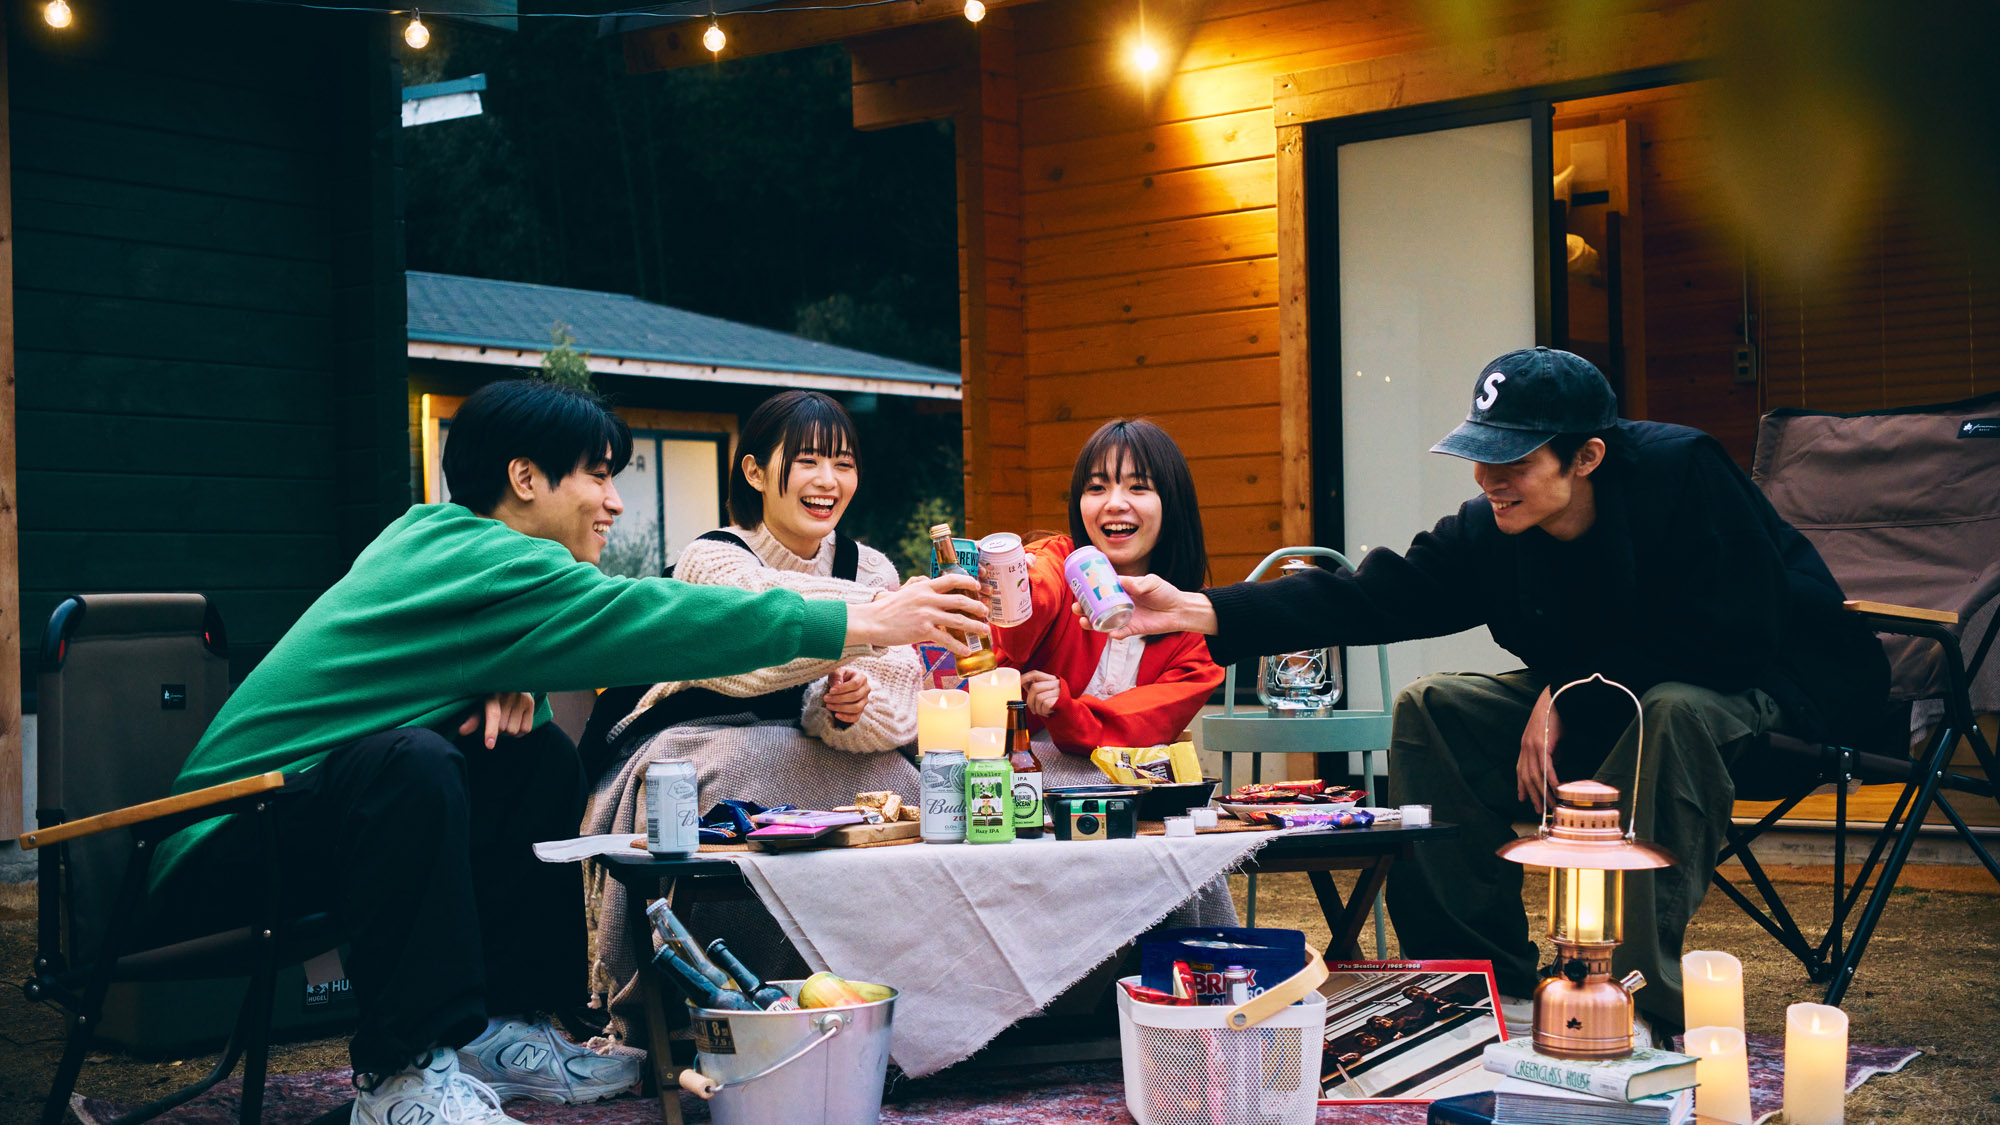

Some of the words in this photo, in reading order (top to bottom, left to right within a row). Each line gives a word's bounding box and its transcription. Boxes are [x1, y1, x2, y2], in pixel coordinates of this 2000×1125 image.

[1475, 371, 1506, 411] S
[332, 979, 352, 993] HU
[514, 1043, 549, 1072] N
[1566, 1069, 1592, 1092] HOUSE
